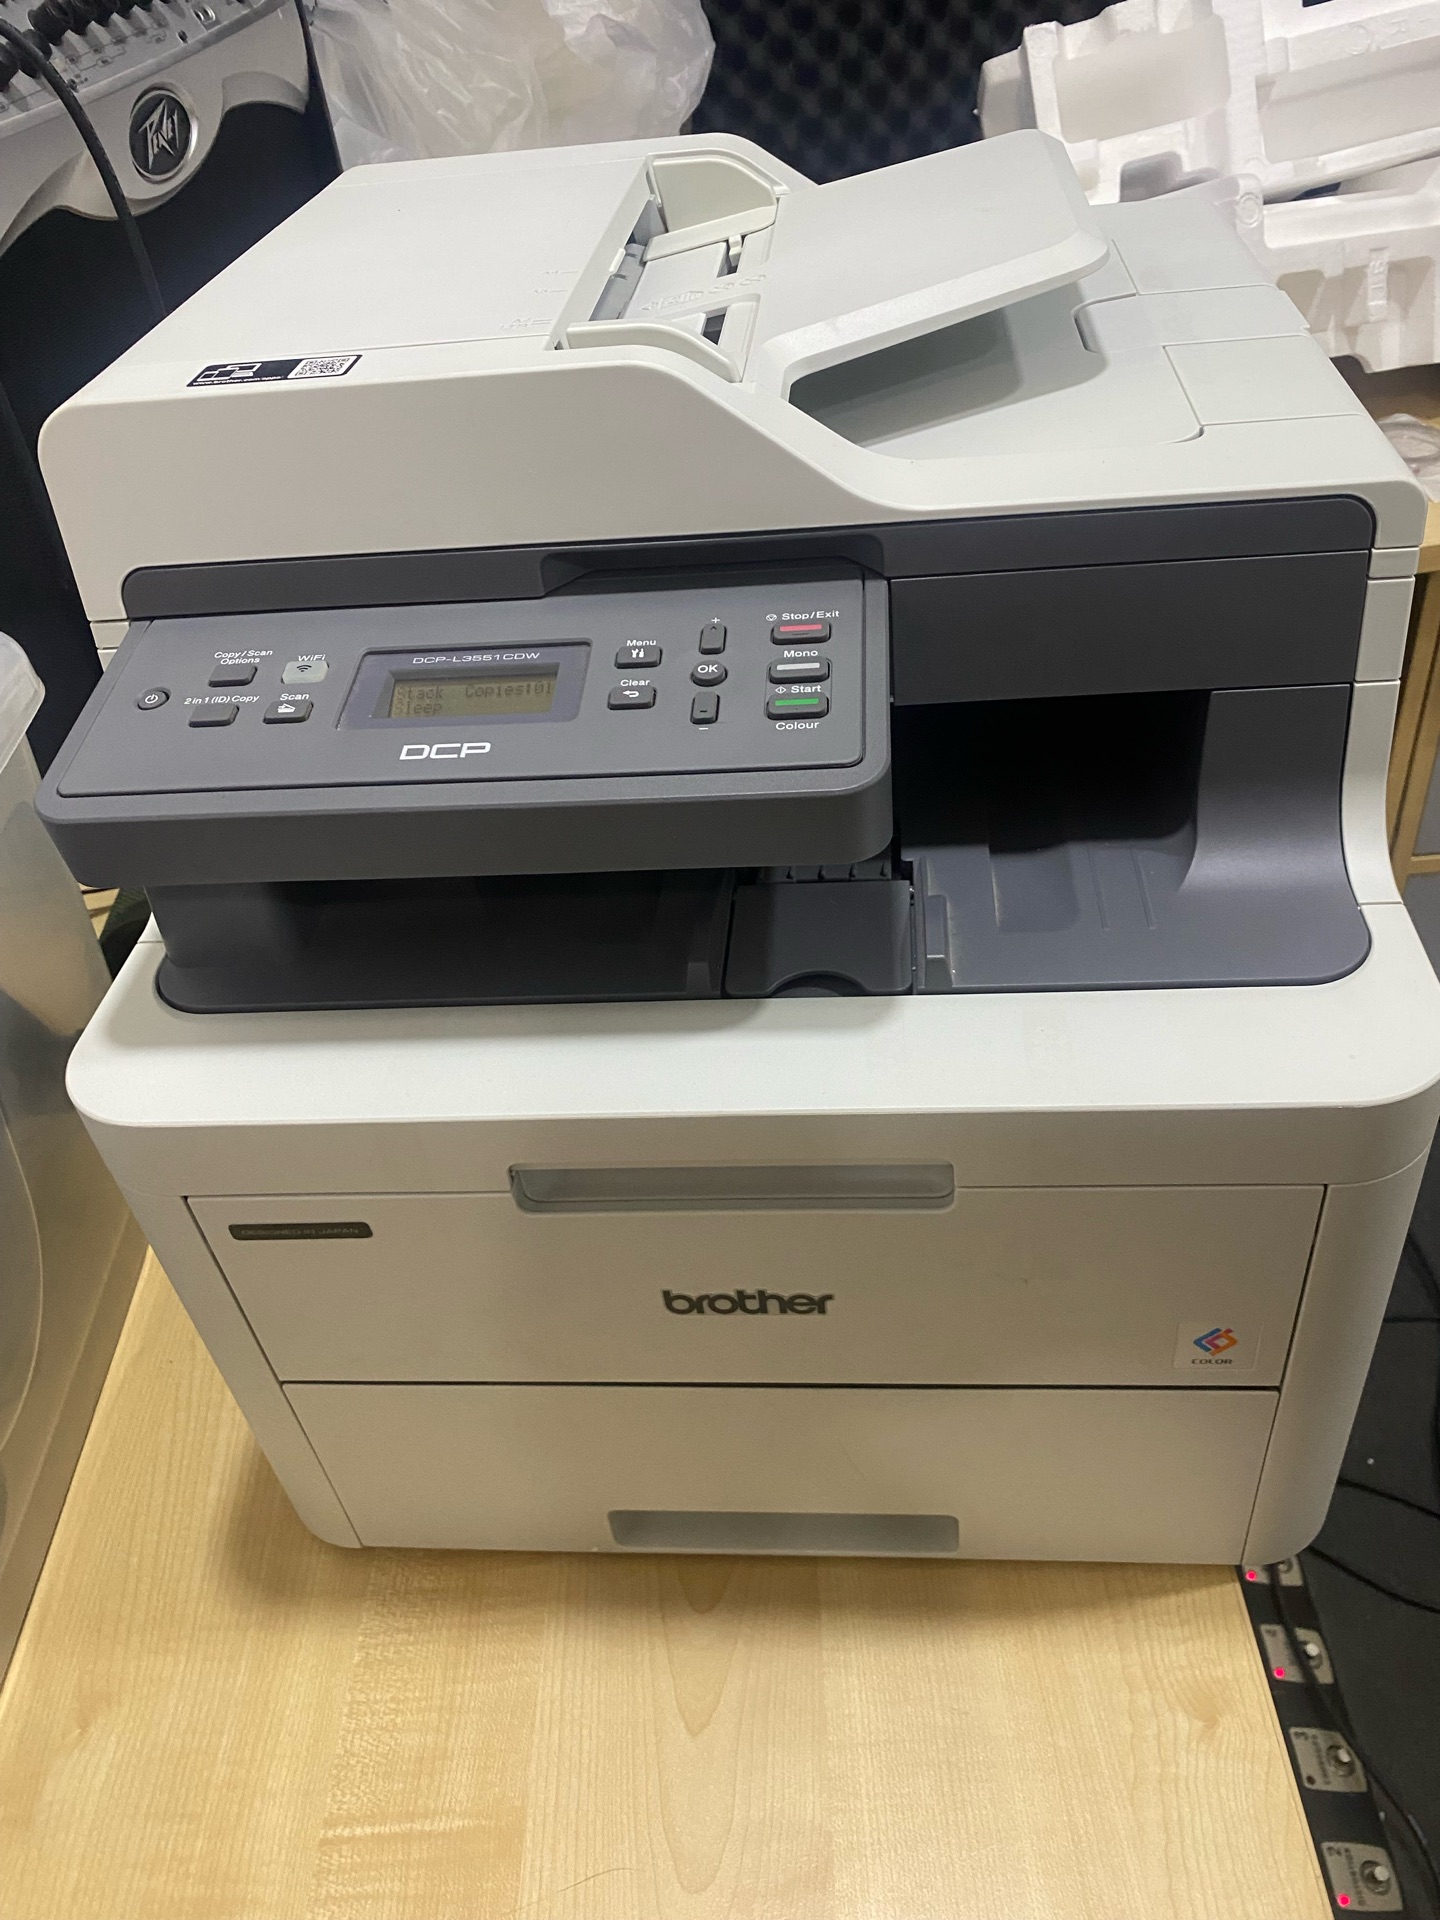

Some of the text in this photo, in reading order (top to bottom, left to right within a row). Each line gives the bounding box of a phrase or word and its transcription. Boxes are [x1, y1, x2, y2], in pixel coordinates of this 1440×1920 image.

[781, 610, 840, 621] Stop/Exit
[626, 639, 657, 647] Menu
[214, 650, 273, 660] Copy/Scan
[298, 654, 326, 662] WiFi
[412, 652, 540, 664] DCP-L3551CDW
[783, 650, 819, 658] Mono
[220, 657, 260, 666] Options
[697, 664, 719, 673] OK
[620, 679, 650, 687] Clear
[397, 685, 444, 699] Stack
[790, 684, 822, 694] Start
[211, 695, 230, 704] (ID)
[231, 695, 260, 703] Copy
[280, 693, 310, 701] Scan
[395, 698, 443, 716] Sleep
[775, 721, 820, 731] Colour
[399, 741, 492, 761] DCP
[318, 1227, 360, 1235] JAPAN
[660, 1288, 835, 1315] brother
